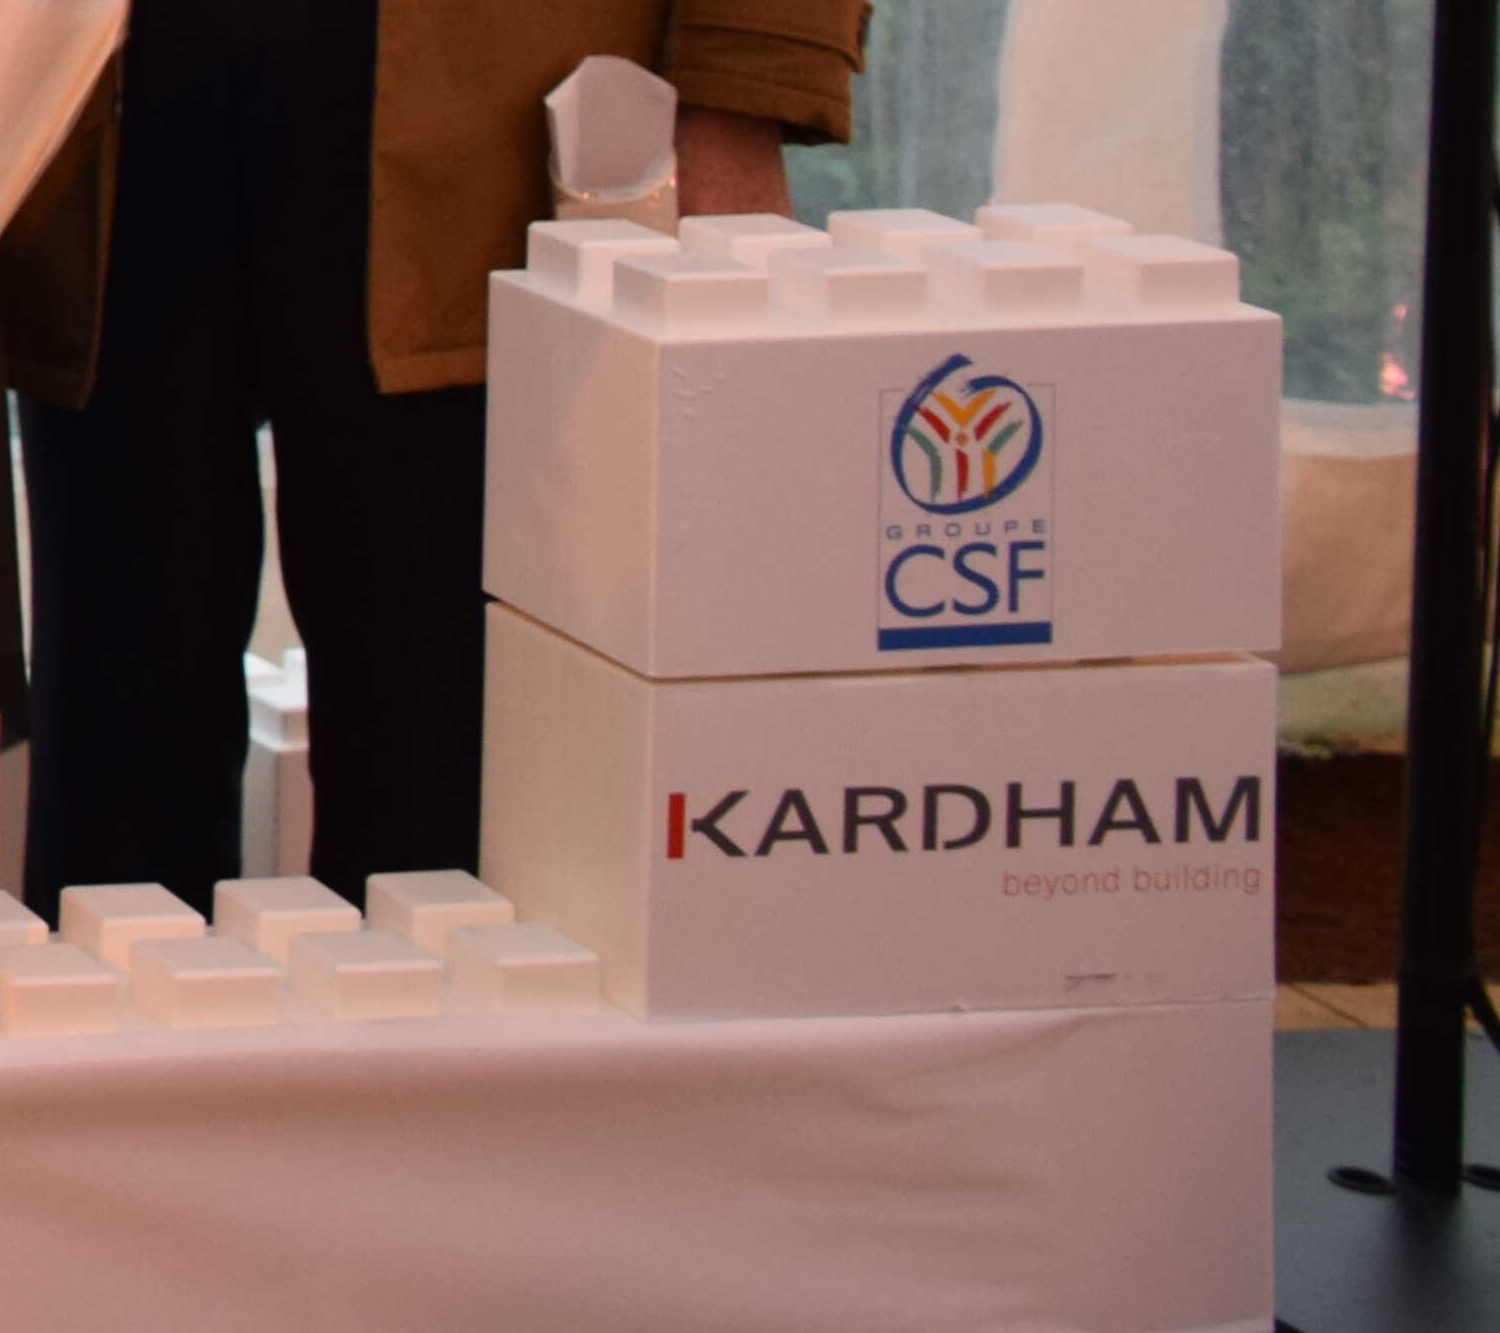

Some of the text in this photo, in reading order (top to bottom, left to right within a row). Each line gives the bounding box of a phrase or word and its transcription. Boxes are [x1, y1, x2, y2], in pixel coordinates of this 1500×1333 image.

[885, 518, 1046, 540] GROUPE
[884, 540, 1046, 618] CSF
[666, 775, 1262, 860] KARDHAM
[1001, 862, 1262, 898] beyond building
